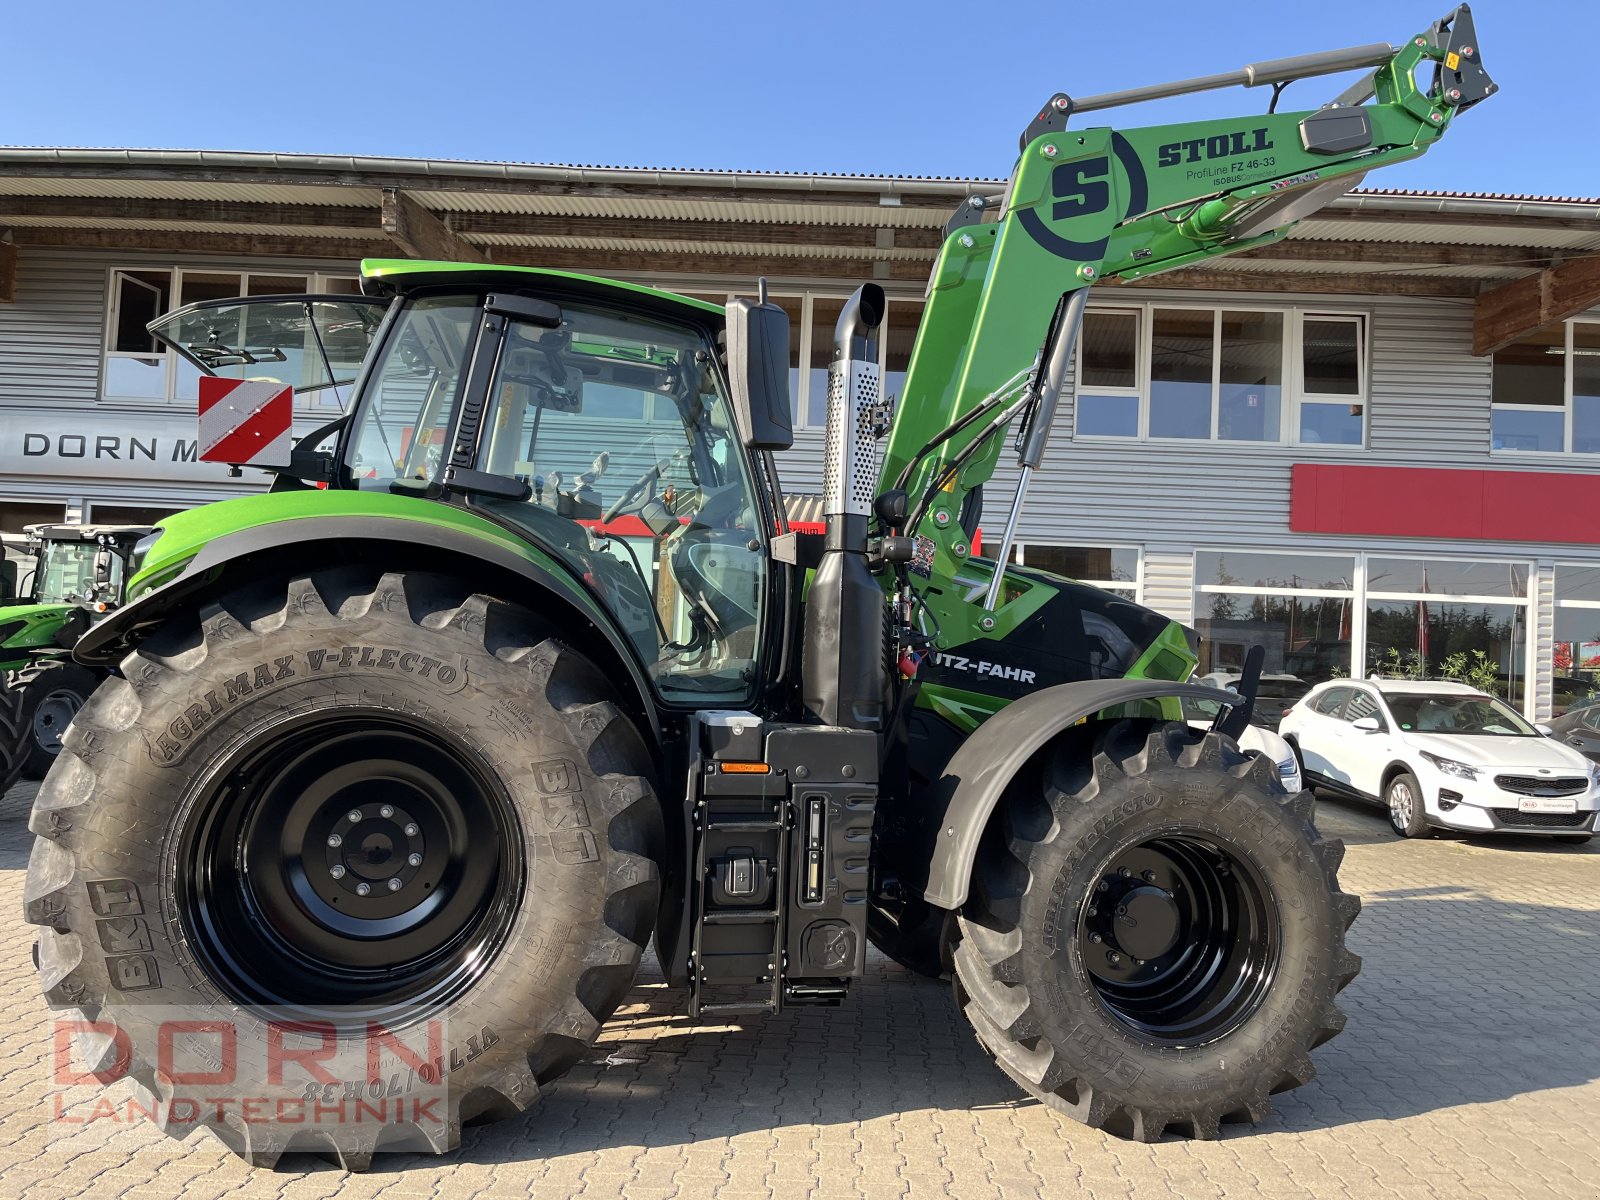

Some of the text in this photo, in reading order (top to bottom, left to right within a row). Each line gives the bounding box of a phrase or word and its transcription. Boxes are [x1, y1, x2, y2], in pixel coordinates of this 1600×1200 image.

[1158, 127, 1274, 168] STOLL
[1186, 156, 1276, 180] ProfiLine FZ 46-33
[23, 433, 157, 461] DORN
[155, 646, 457, 761] AGRIMAX V-FLECTO
[534, 760, 596, 864] BKT
[89, 880, 158, 991] BKT
